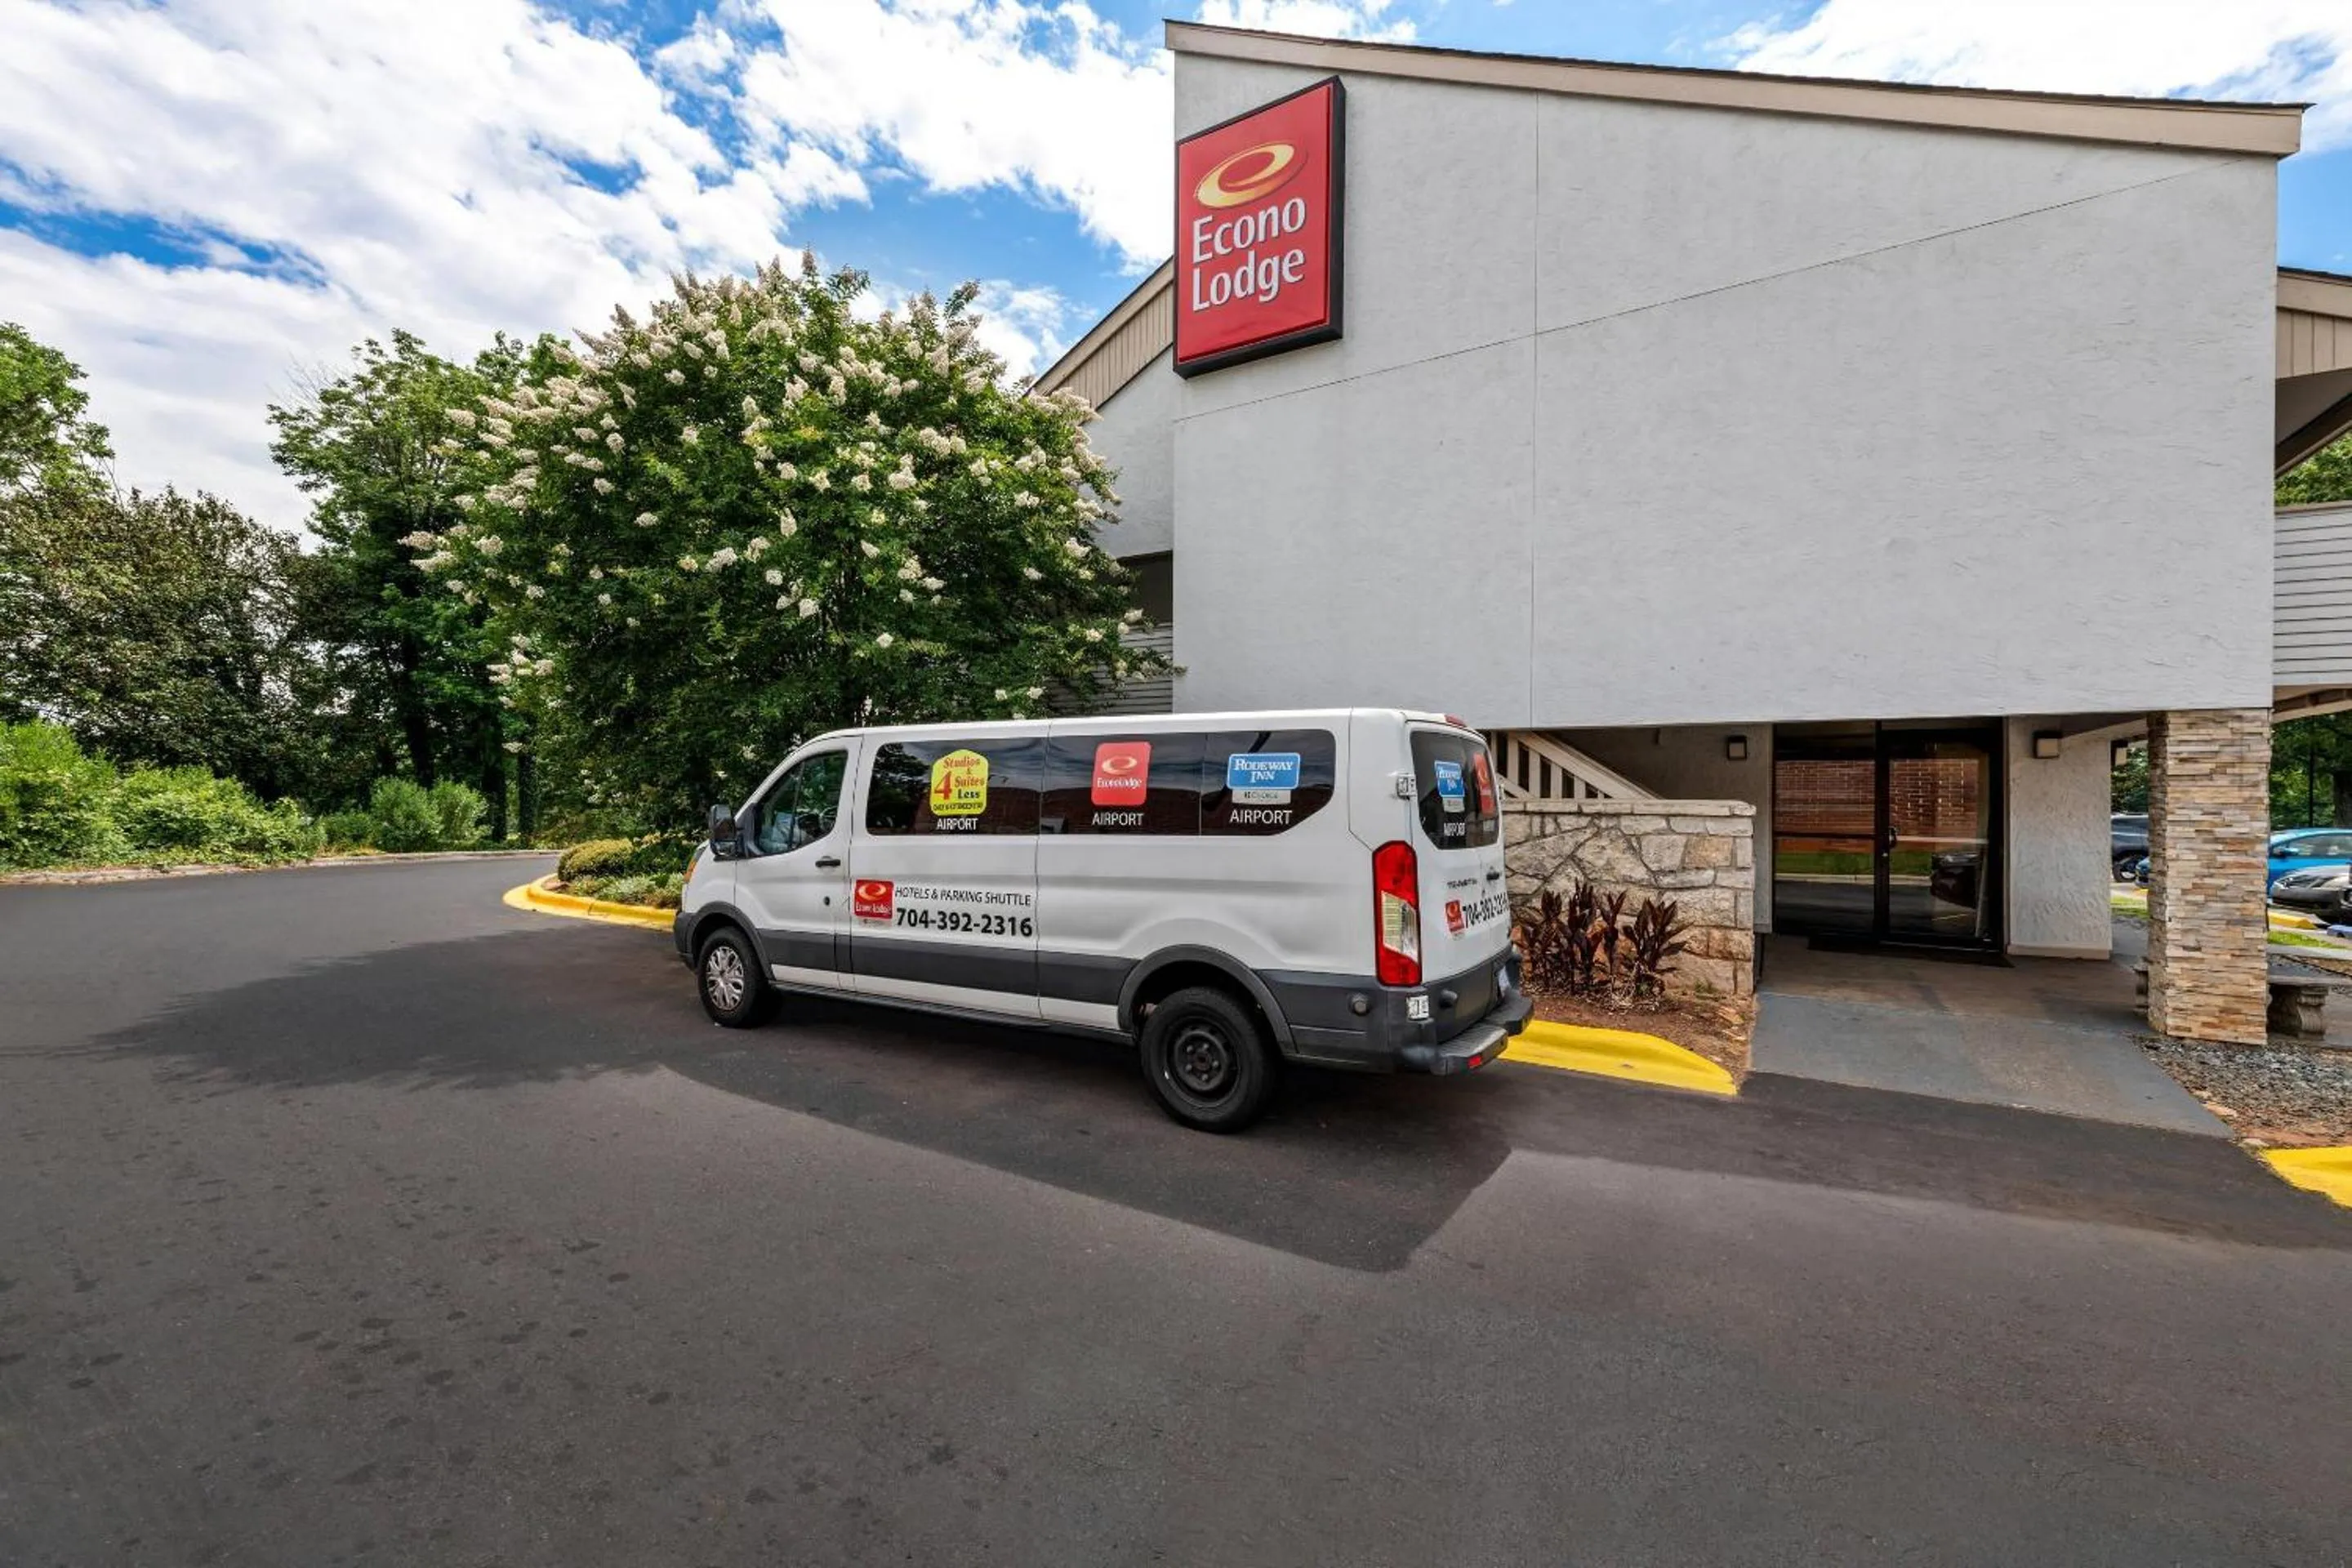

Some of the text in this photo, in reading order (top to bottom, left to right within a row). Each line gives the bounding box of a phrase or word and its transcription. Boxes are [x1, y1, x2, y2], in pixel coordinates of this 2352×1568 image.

[1192, 198, 1306, 264] Econo
[1192, 248, 1305, 312] Lodge
[933, 770, 953, 800] 4
[1250, 771, 1276, 783] INN
[957, 788, 981, 800] Less
[936, 817, 978, 831] AIRPORT
[1091, 811, 1144, 826] AIRPORT
[1229, 809, 1293, 825] AIRPORT
[895, 887, 1031, 906] HOTELS & PARKING SHUTTLE
[896, 907, 1033, 938] 704-392-2316
